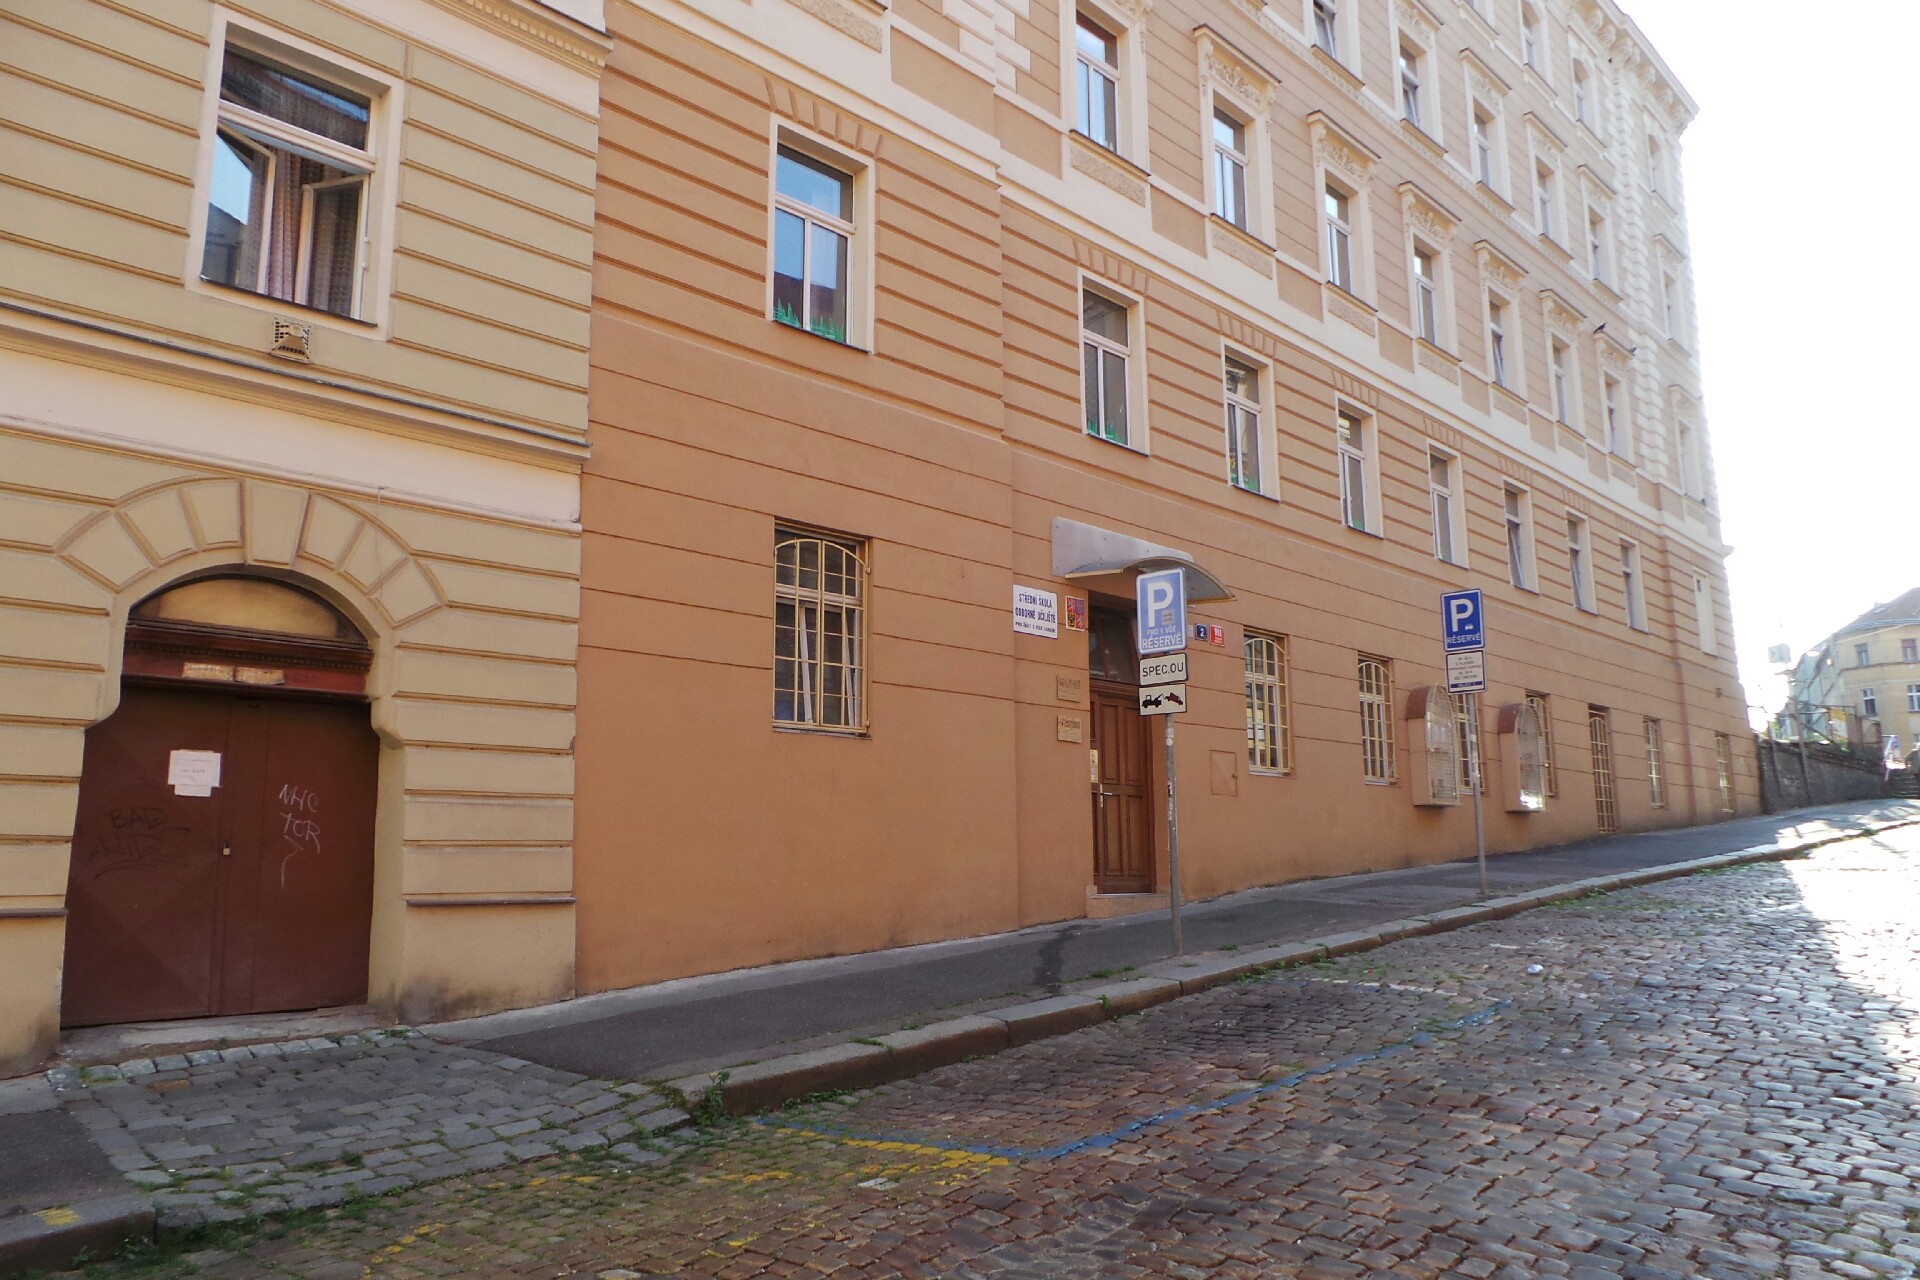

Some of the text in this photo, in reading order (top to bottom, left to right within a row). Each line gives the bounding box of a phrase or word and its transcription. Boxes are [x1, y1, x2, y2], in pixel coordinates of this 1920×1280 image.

[1018, 591, 1052, 608] STŘEDNÍ ŠKOLA
[1147, 582, 1173, 628] P
[1015, 607, 1035, 619] ODBORNÉ
[1450, 598, 1474, 632] P
[1147, 628, 1159, 636] PRO
[1200, 628, 1205, 637] 2
[1142, 632, 1182, 649] RÉSERVÉ
[1142, 662, 1184, 677] SPEC.OU
